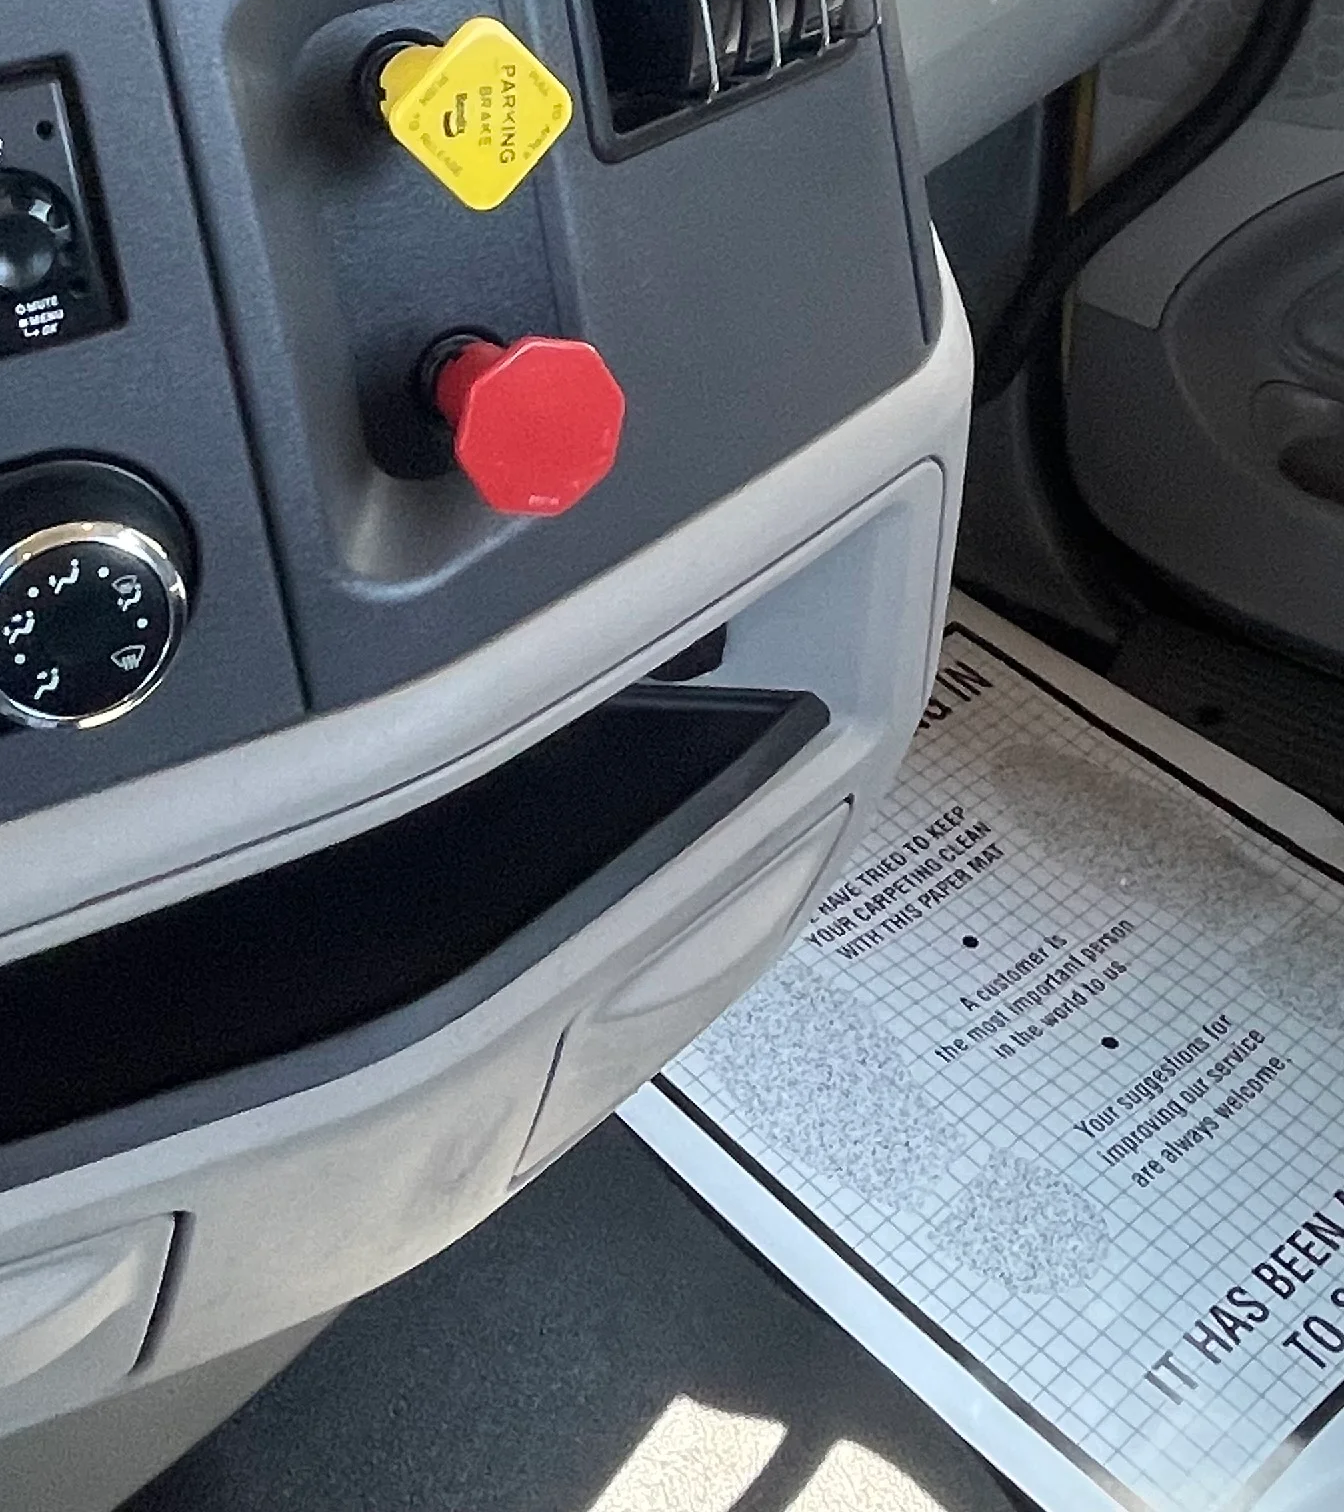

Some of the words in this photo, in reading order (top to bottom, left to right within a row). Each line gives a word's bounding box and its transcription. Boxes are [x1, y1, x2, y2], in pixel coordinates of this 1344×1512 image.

[478, 85, 493, 148] BRAKE
[499, 64, 516, 164] PARKING
[807, 916, 859, 948] YOUR
[853, 858, 943, 922] CARPETING
[938, 821, 992, 863] CLEAN
[818, 881, 863, 916] HAVE
[855, 851, 907, 887] TRIED
[903, 834, 930, 856] TO
[925, 805, 966, 840] KEEP
[835, 929, 885, 960] WITH
[880, 903, 923, 934] THIS
[917, 868, 974, 910] PAPER
[966, 842, 1005, 874] MAT
[934, 1038, 969, 1064] the
[967, 1009, 1011, 1043] most
[1008, 953, 1086, 1016] important
[1080, 919, 1135, 963] person
[959, 996, 981, 1012] A
[976, 947, 1050, 1002] customer
[1044, 934, 1068, 950] is
[991, 1042, 1017, 1060] in
[1008, 1024, 1044, 1048] the
[1040, 989, 1089, 1028] world
[1081, 977, 1106, 996] to
[1073, 1105, 1121, 1139] Your
[1117, 1036, 1210, 1111] suggestions
[1202, 1014, 1234, 1041] for
[1096, 1098, 1188, 1167] improving
[1179, 1076, 1210, 1105] our
[1206, 1029, 1266, 1084] service
[1131, 1159, 1166, 1188] are
[1160, 1116, 1220, 1164] always
[1213, 1056, 1293, 1120] welcome.
[1144, 1350, 1199, 1406] IT
[1182, 1286, 1271, 1365] HAS
